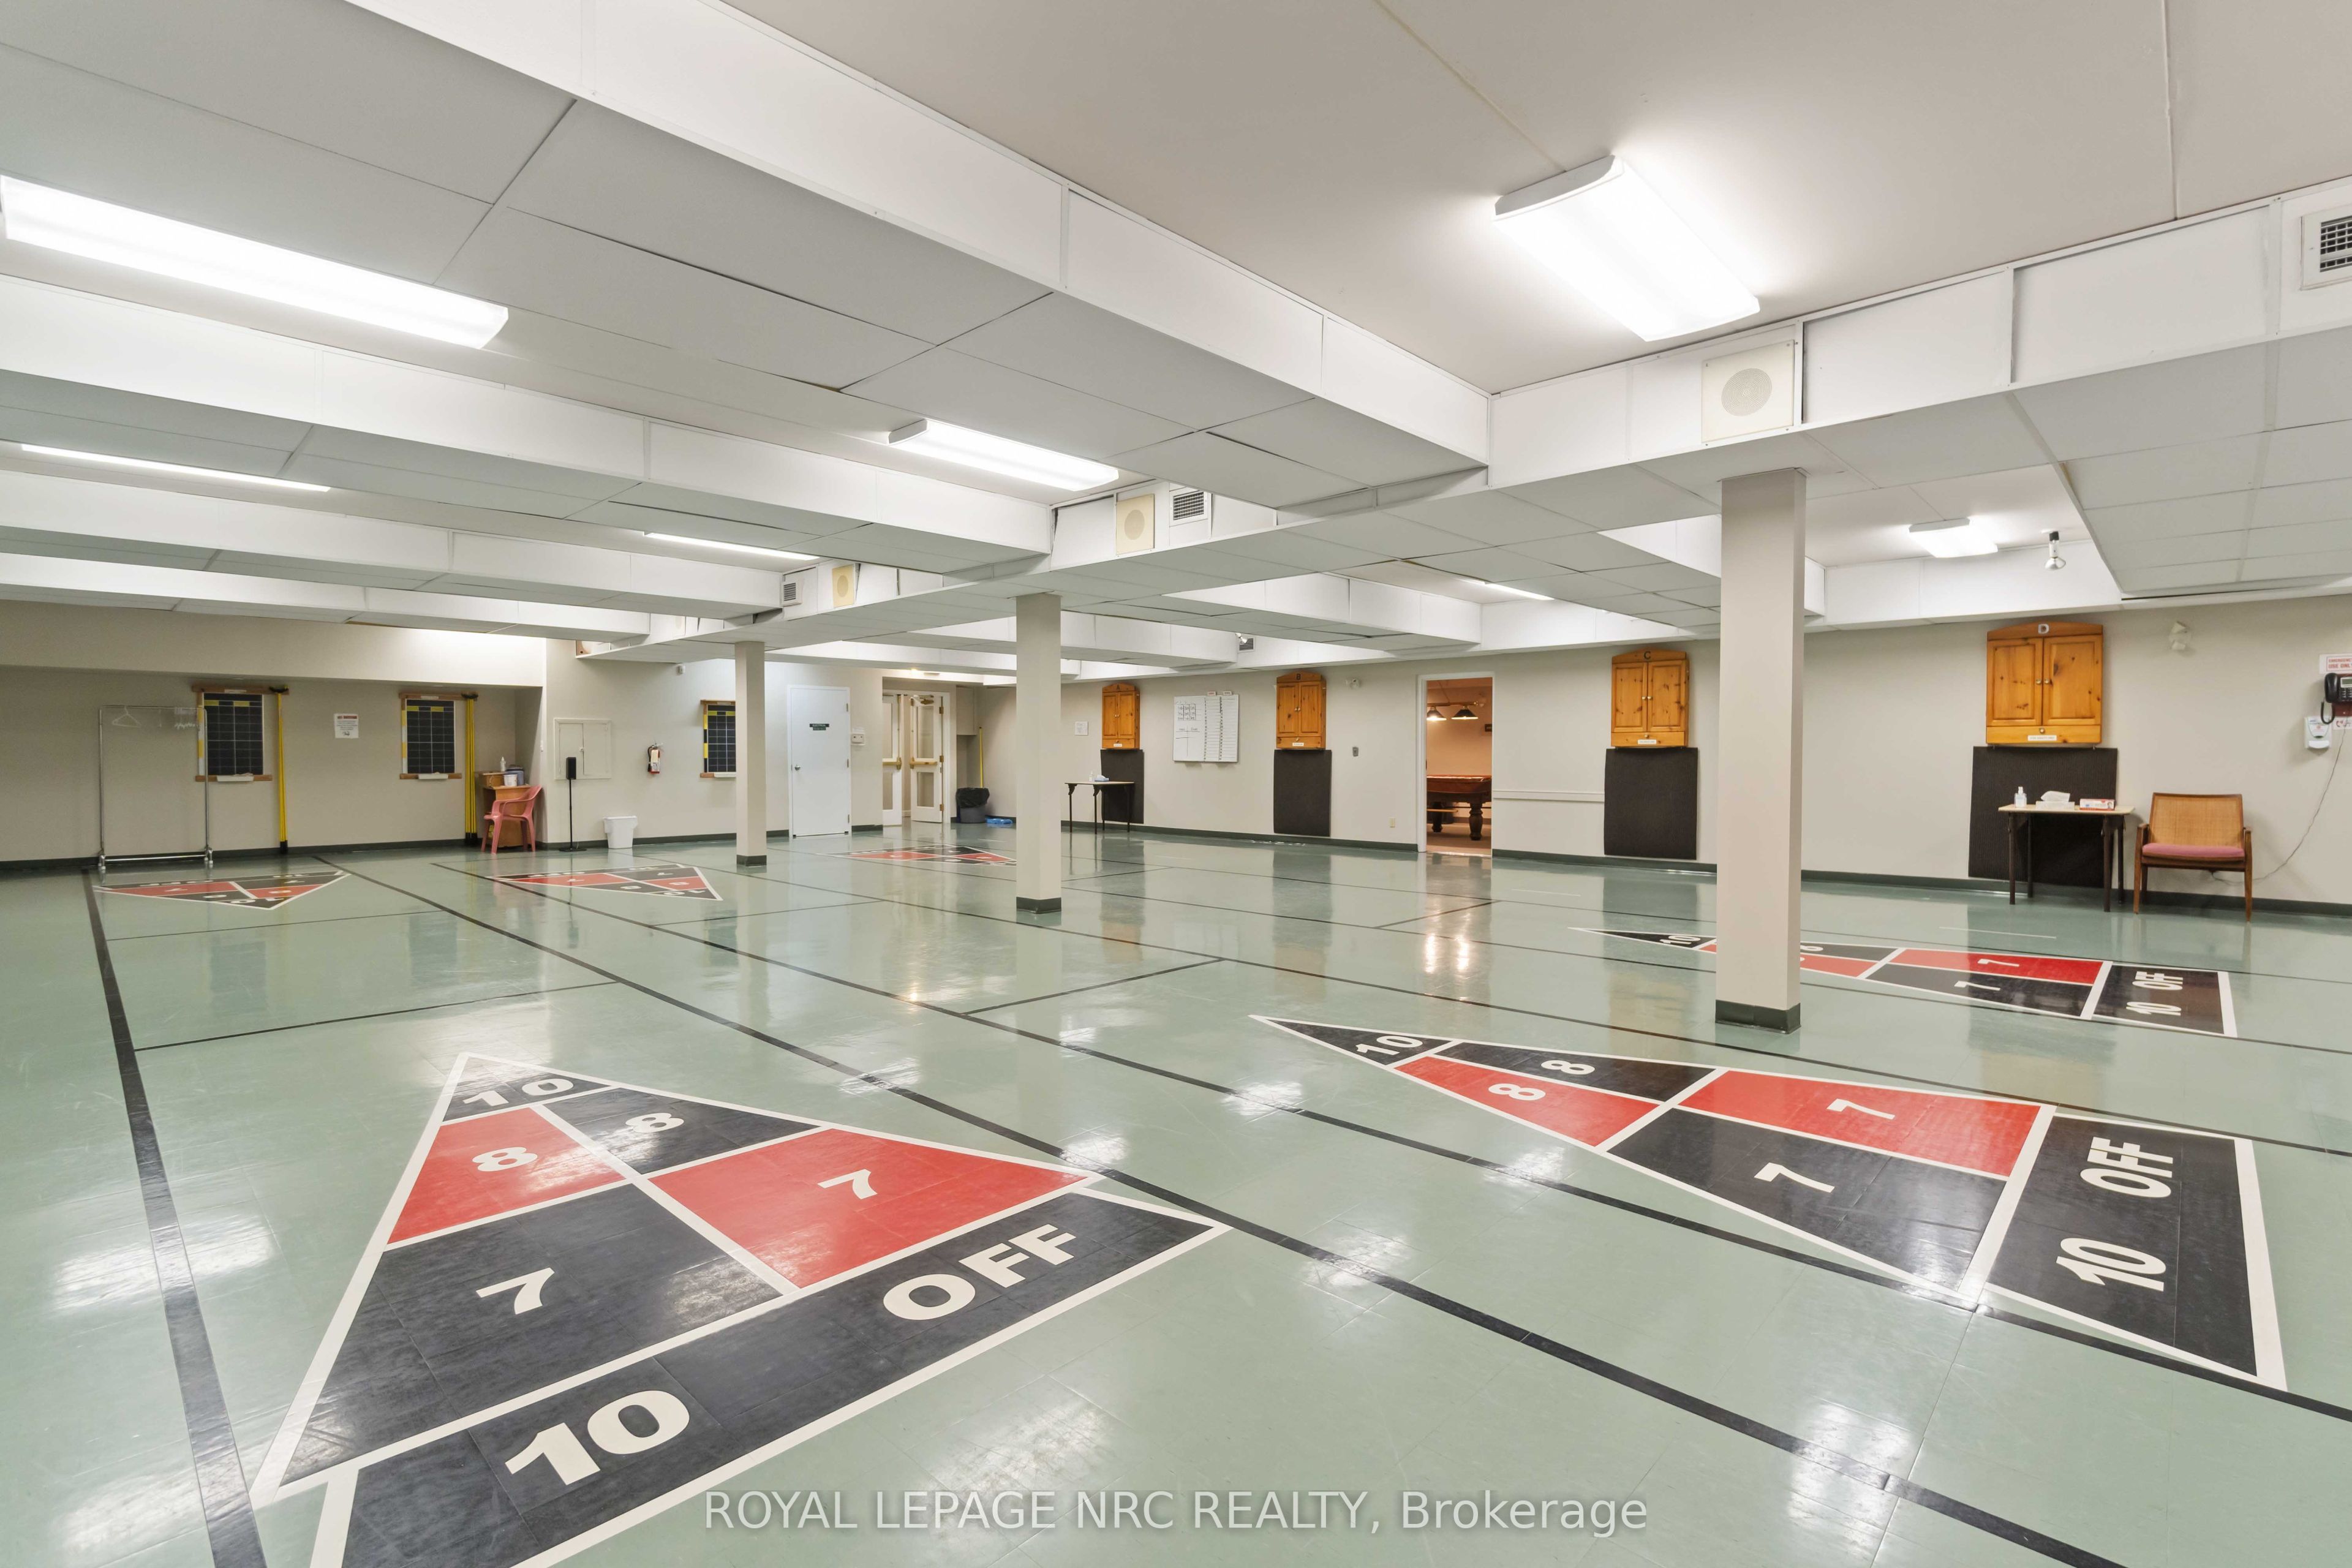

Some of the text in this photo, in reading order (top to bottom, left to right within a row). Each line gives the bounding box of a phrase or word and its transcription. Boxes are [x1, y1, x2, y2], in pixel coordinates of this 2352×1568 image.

[2038, 624, 2049, 635] D
[1643, 650, 1651, 660] C
[1660, 935, 1701, 944] 10
[1978, 959, 2020, 967] 7
[1954, 981, 2001, 991] 7
[2126, 971, 2184, 1016] 10 OFF
[1355, 1035, 1423, 1055] 10
[1540, 1060, 1596, 1075] 8
[462, 1077, 575, 1106] 10
[1488, 1083, 1547, 1101] 8
[1826, 1098, 1896, 1120] 7
[624, 1112, 686, 1136] 8
[472, 1146, 538, 1172] 8
[817, 1168, 878, 1200] 7
[1753, 1161, 1836, 1194] 7
[2055, 1136, 2174, 1292] 10 OFF
[475, 1267, 556, 1315] 7
[505, 1223, 1078, 1486] 10 OFF
